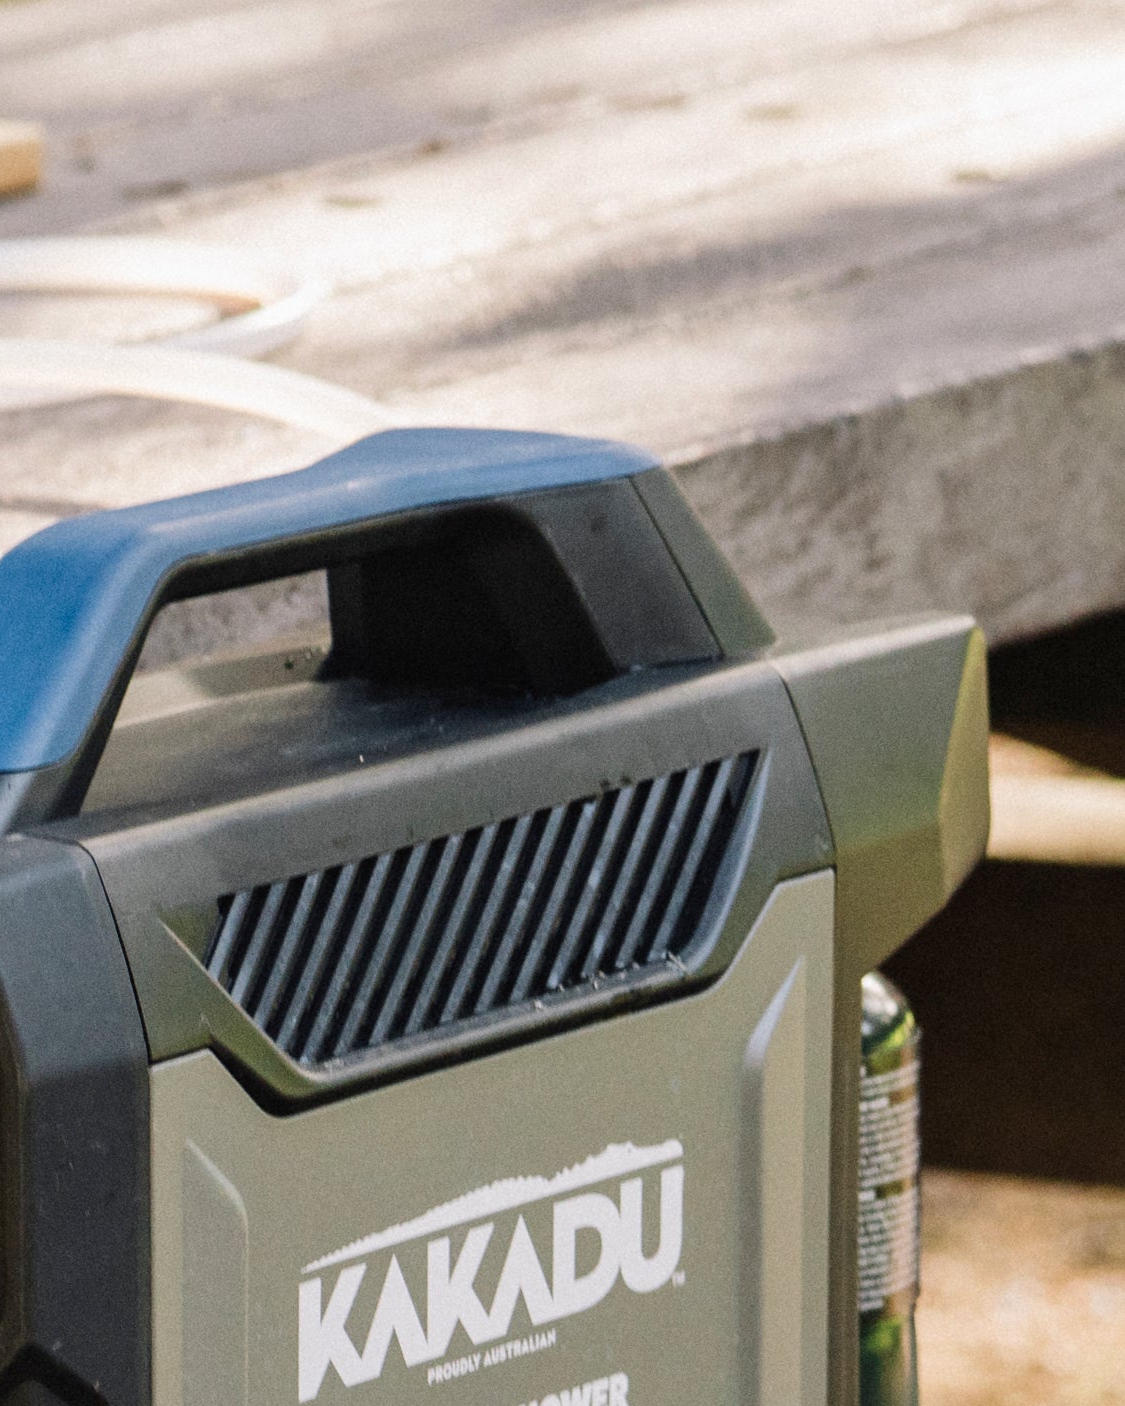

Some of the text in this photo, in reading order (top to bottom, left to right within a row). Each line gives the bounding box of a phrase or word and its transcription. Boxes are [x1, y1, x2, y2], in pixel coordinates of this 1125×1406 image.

[298, 1164, 685, 1404] KAKADU
[427, 1327, 557, 1387] PROUDLY AUSTRALIAN
